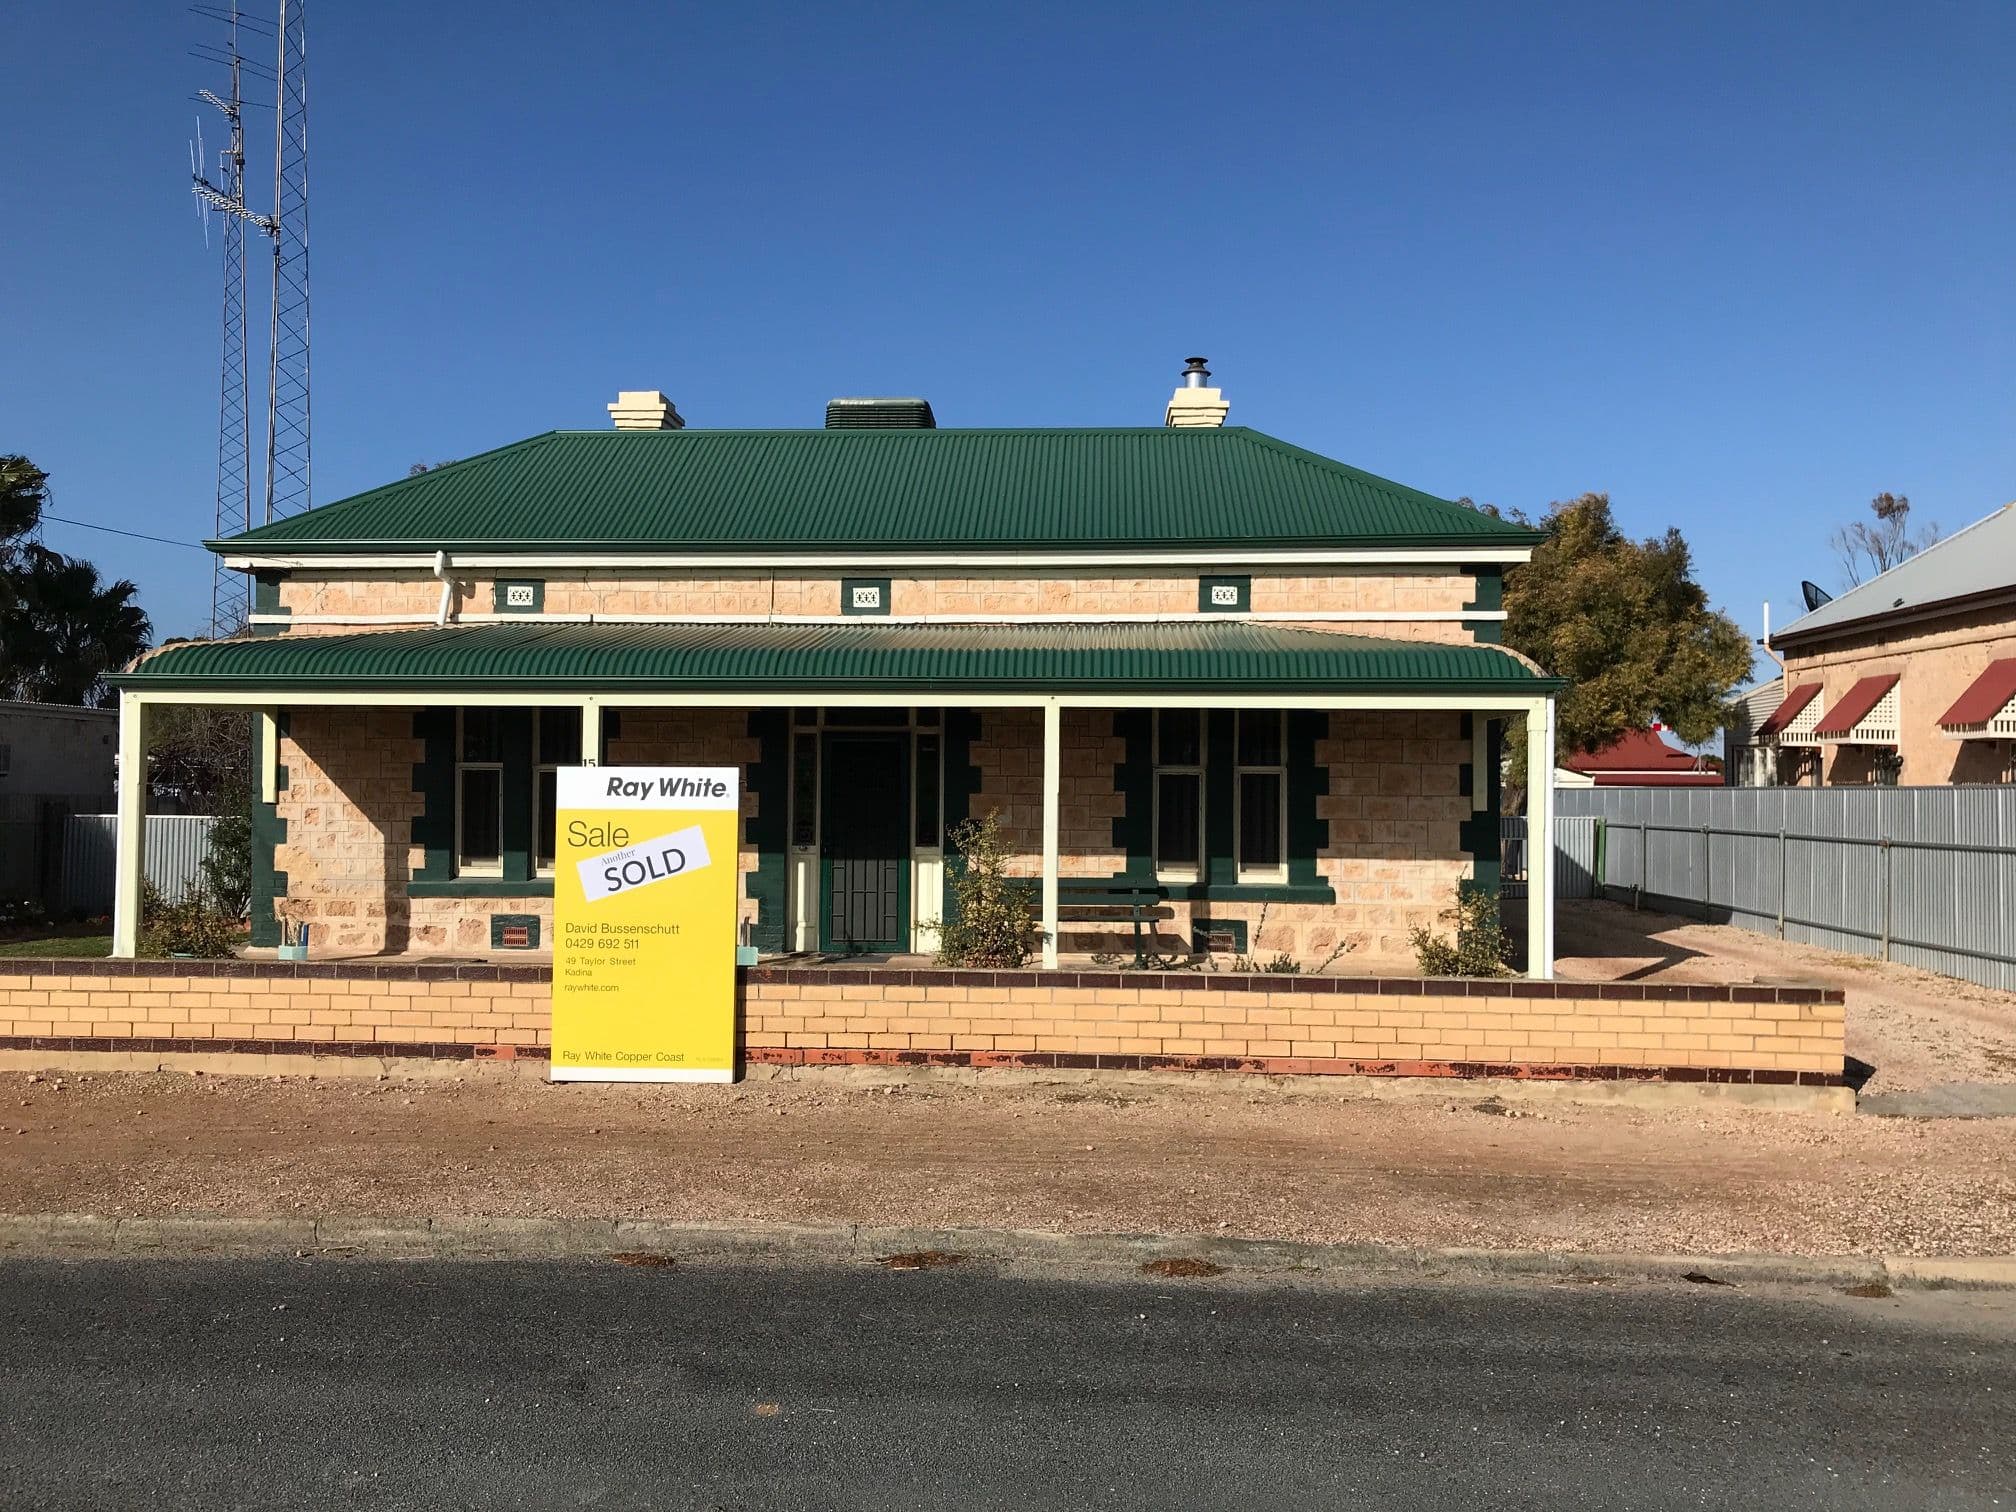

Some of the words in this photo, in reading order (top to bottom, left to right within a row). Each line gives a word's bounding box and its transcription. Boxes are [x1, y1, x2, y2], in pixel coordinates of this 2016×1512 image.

[606, 776, 654, 801] Ray
[659, 777, 727, 798] White
[567, 820, 629, 848] Sale
[601, 848, 636, 866] Another
[604, 848, 686, 892] SOLD
[565, 922, 597, 934] David
[601, 922, 680, 935] Bussenschutt
[565, 938, 594, 949] 0429
[598, 938, 620, 949] 692
[623, 938, 639, 950] 511
[565, 956, 577, 965] 49
[580, 956, 605, 967] Taylor
[609, 957, 636, 966] Street
[564, 968, 593, 977] Kadina
[564, 983, 619, 993] raywhite.com
[562, 1050, 581, 1063] Ray
[585, 1051, 612, 1061] White
[615, 1051, 652, 1063] Copper
[655, 1052, 685, 1062] Coast
